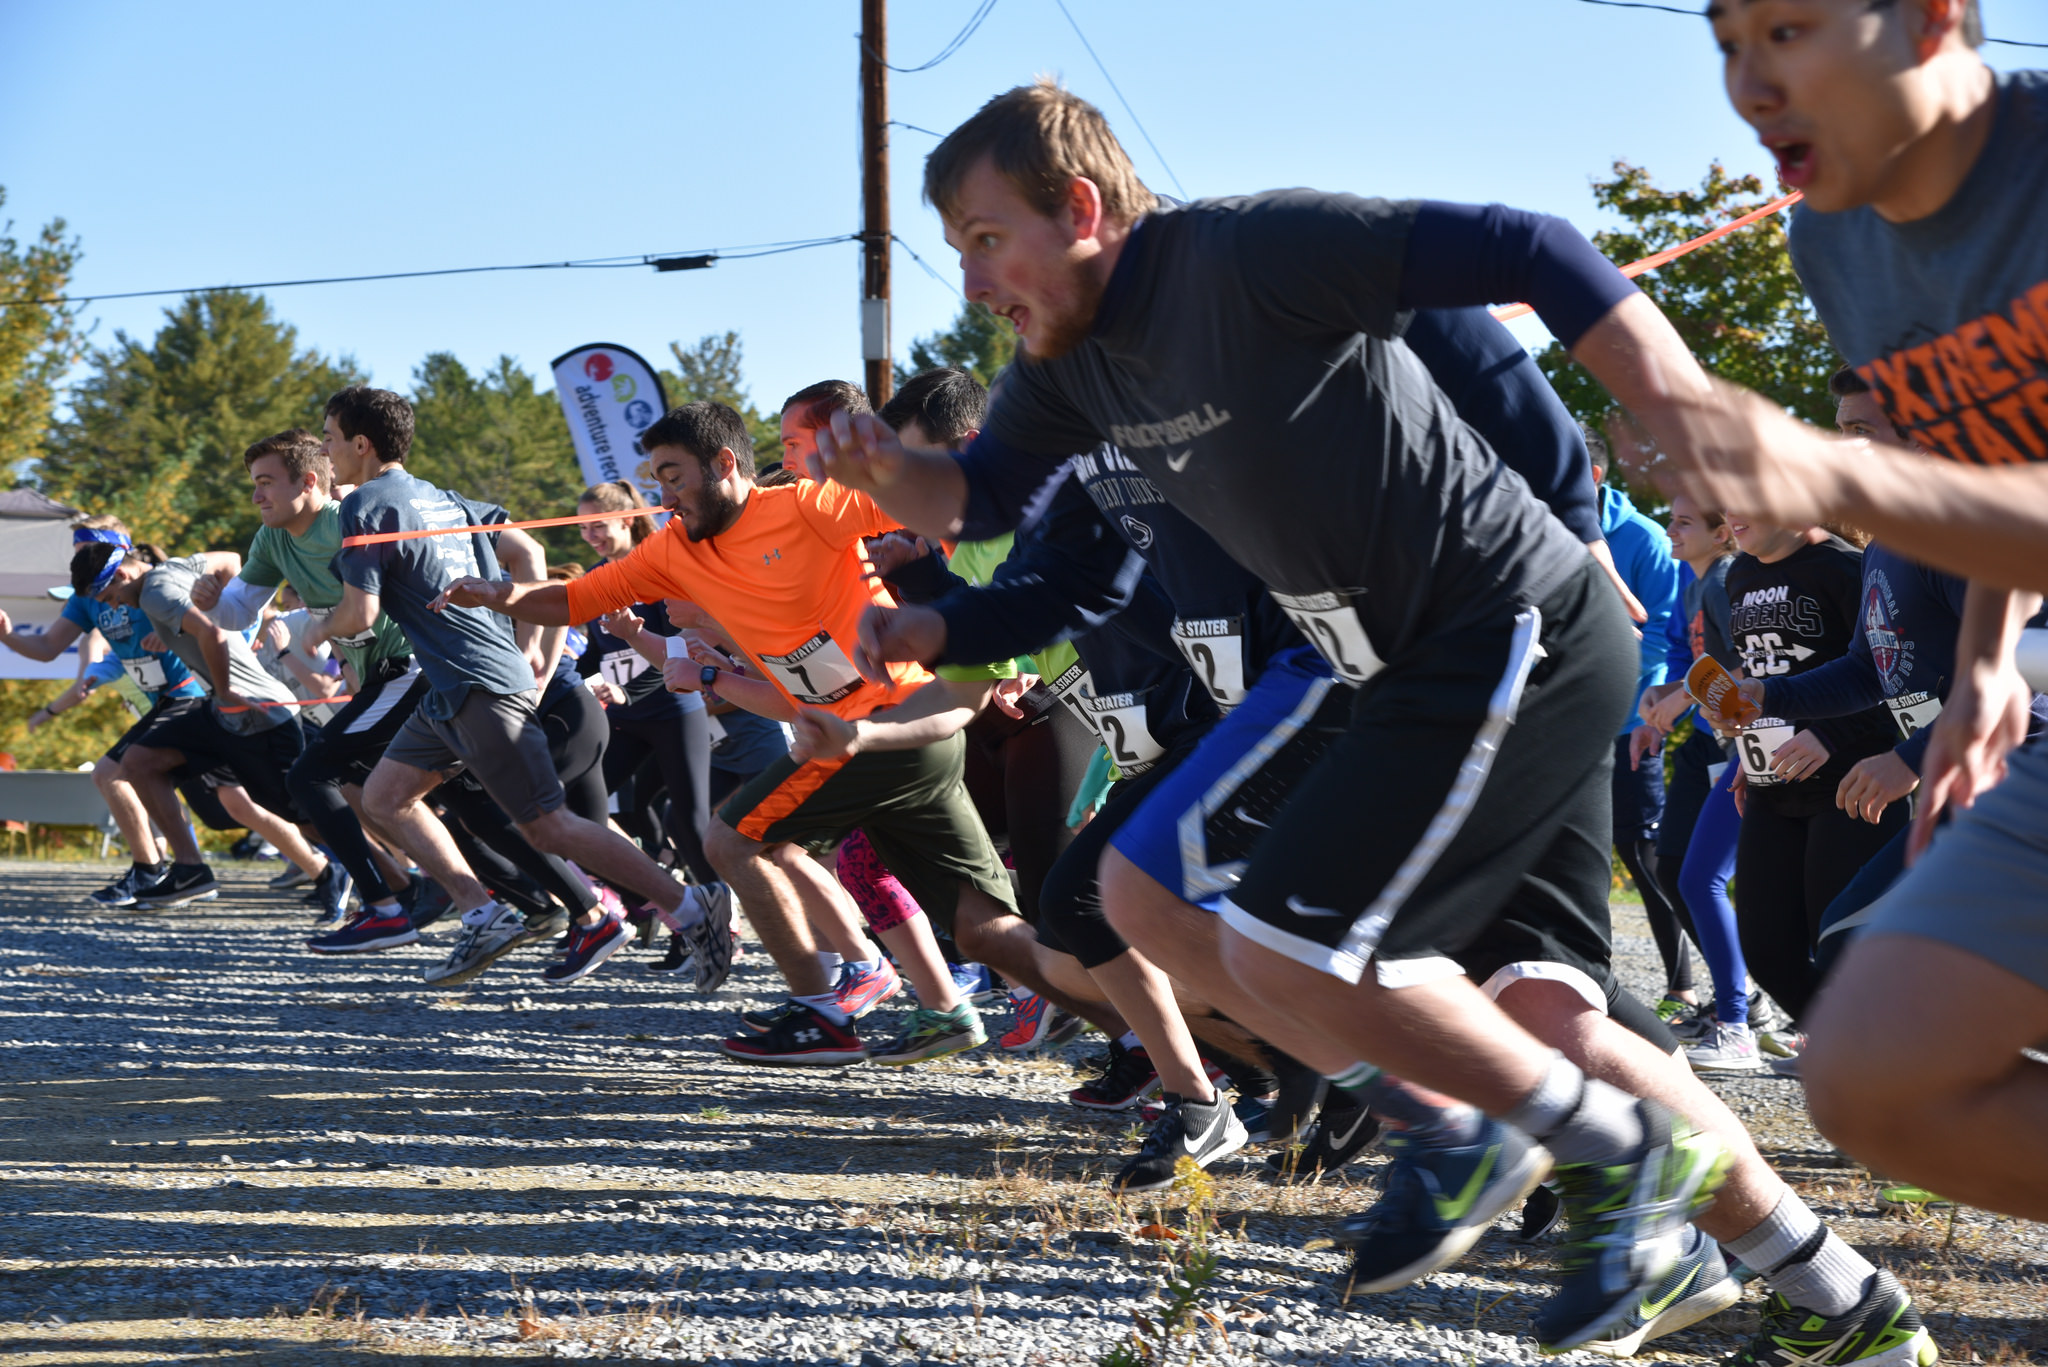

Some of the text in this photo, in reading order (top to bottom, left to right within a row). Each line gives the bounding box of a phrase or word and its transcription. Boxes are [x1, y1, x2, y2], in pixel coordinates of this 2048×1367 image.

[1856, 278, 2048, 427] XTREM
[574, 384, 612, 456] adventure
[1110, 402, 1232, 449] FOOTBALL
[1742, 586, 1789, 607] MOON
[1185, 619, 1229, 637] STATER
[785, 636, 823, 665] STATER
[1744, 632, 1791, 677] CC
[1898, 640, 1915, 677] 1975
[134, 666, 149, 686] 2
[610, 658, 634, 685] 17
[784, 664, 819, 695] 7
[1058, 664, 1083, 694] STATER
[1094, 693, 1135, 711] STATER
[1899, 691, 1929, 709] STATER
[1743, 733, 1767, 773] 6
